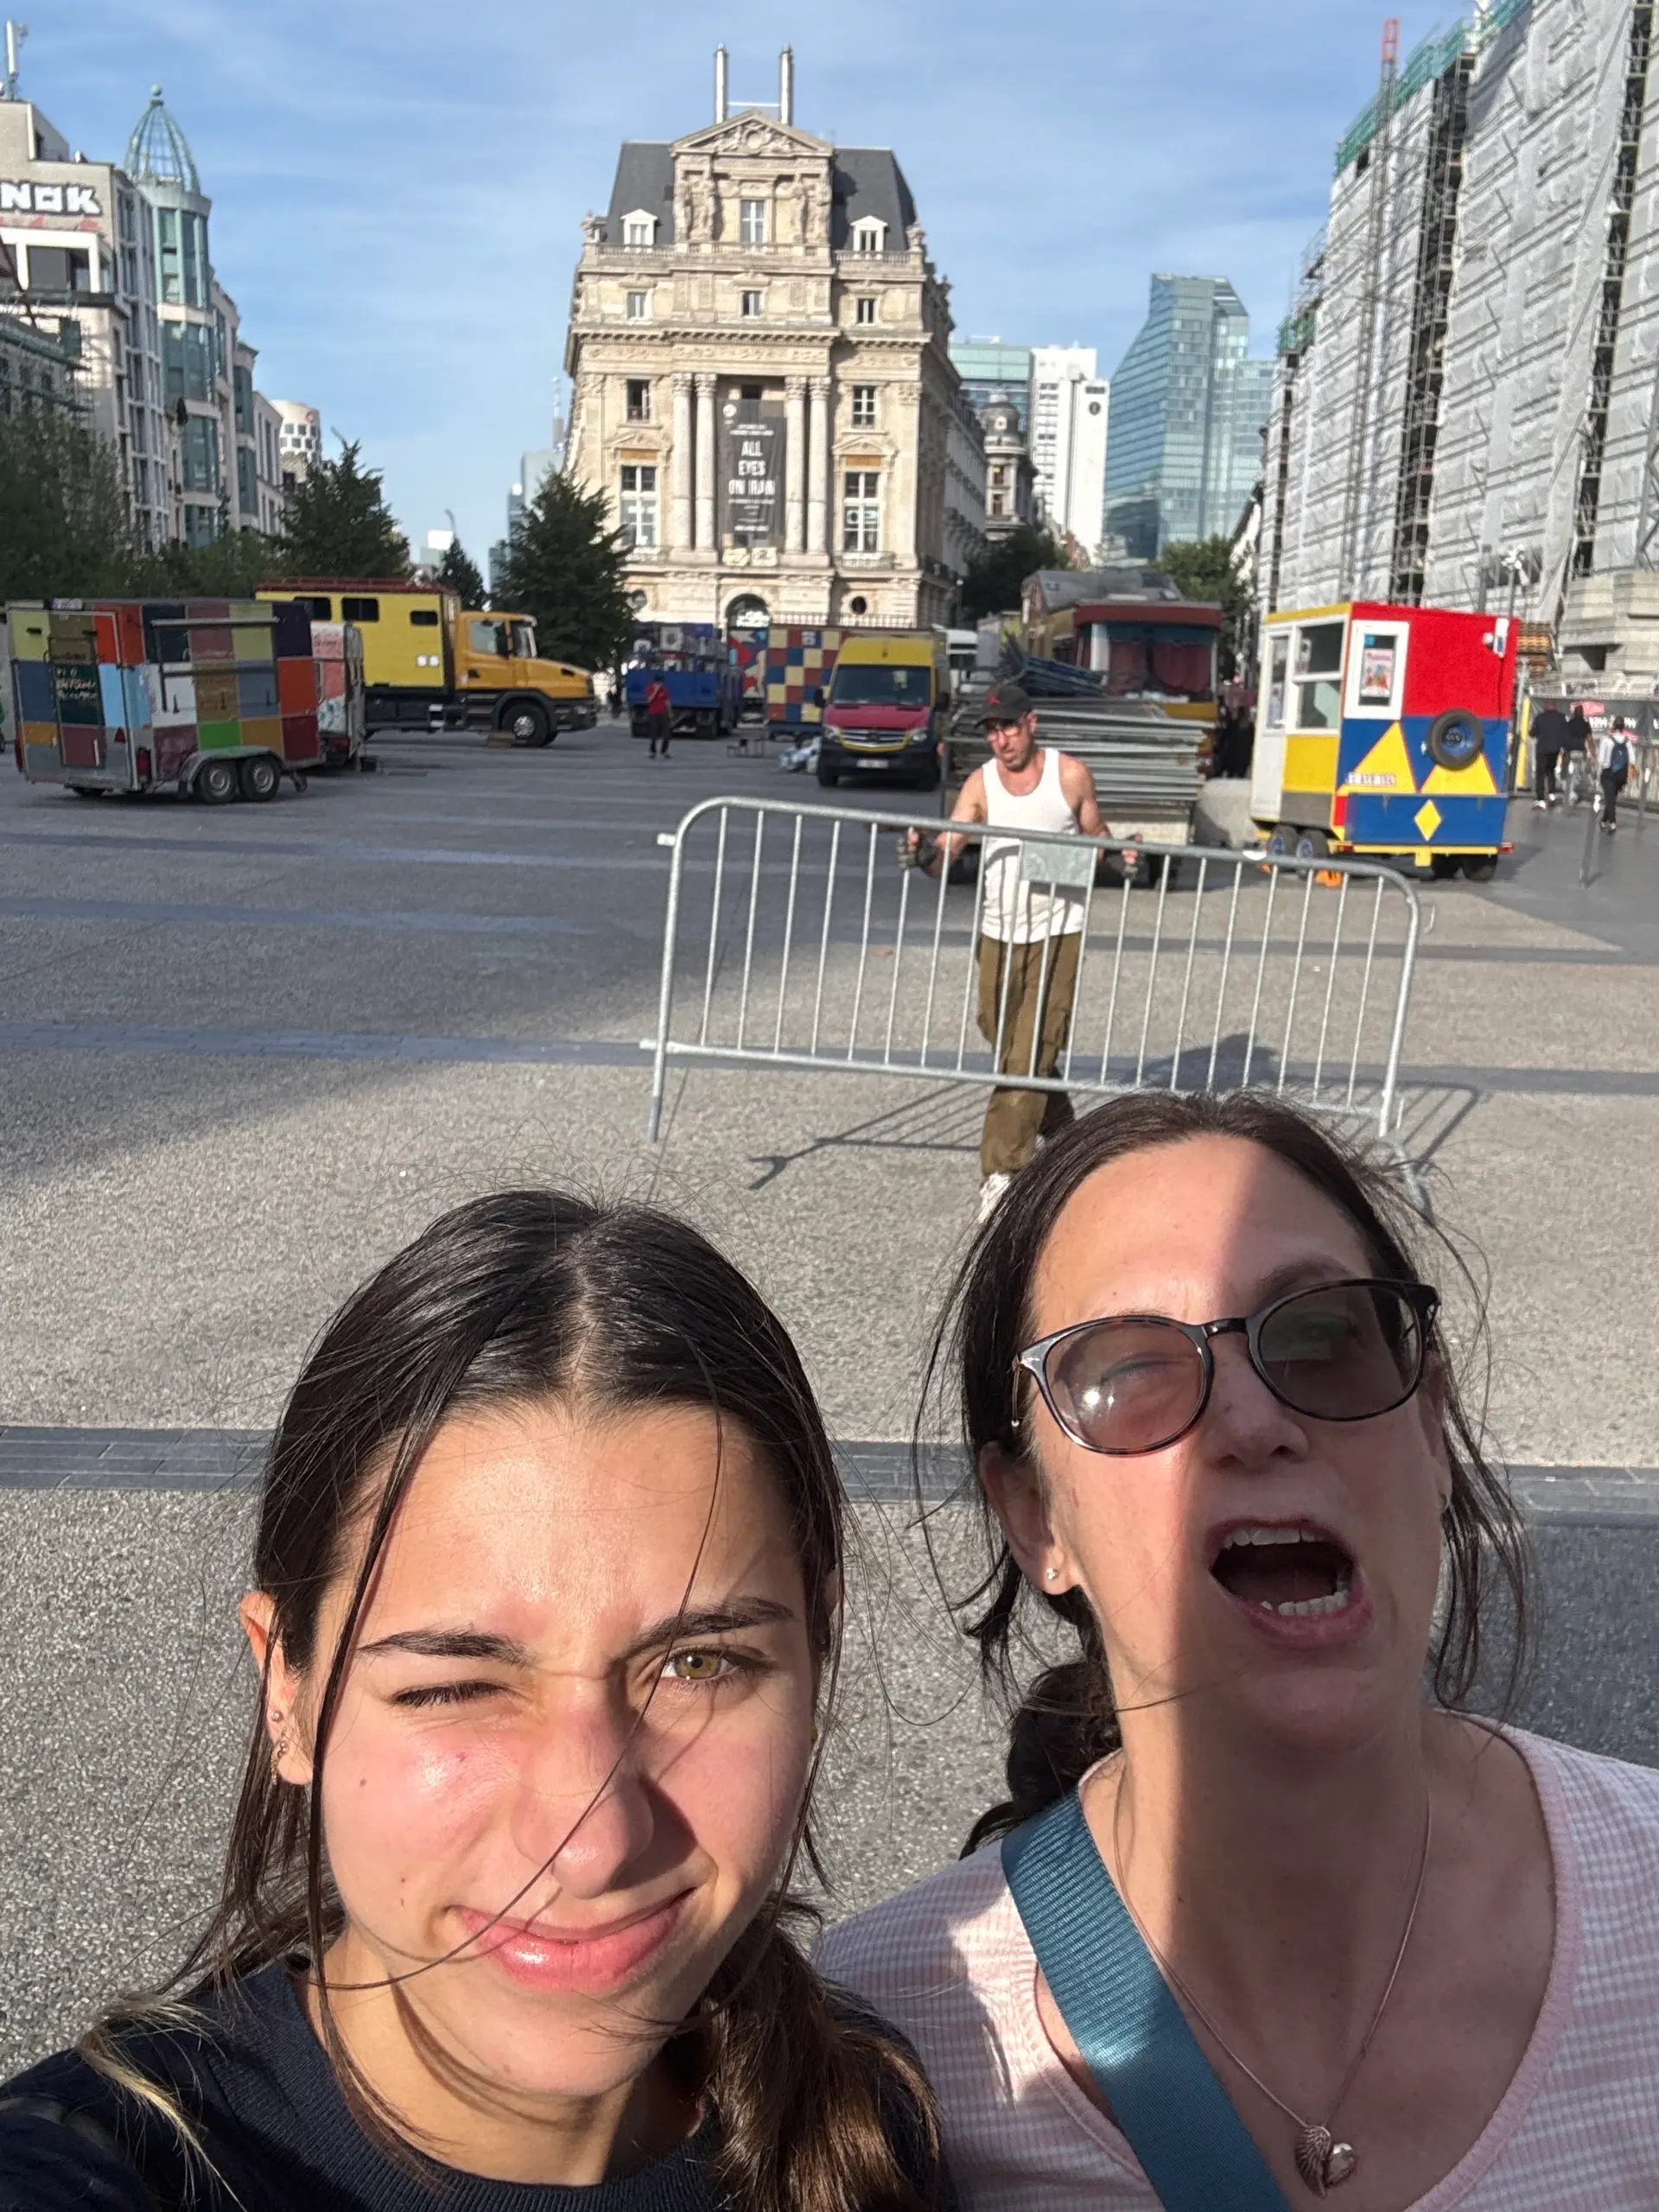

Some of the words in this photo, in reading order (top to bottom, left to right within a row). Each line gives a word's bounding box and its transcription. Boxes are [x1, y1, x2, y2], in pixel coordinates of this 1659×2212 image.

[741, 441, 763, 456] ALL
[738, 460, 766, 476] EYES
[728, 480, 746, 495] ON
